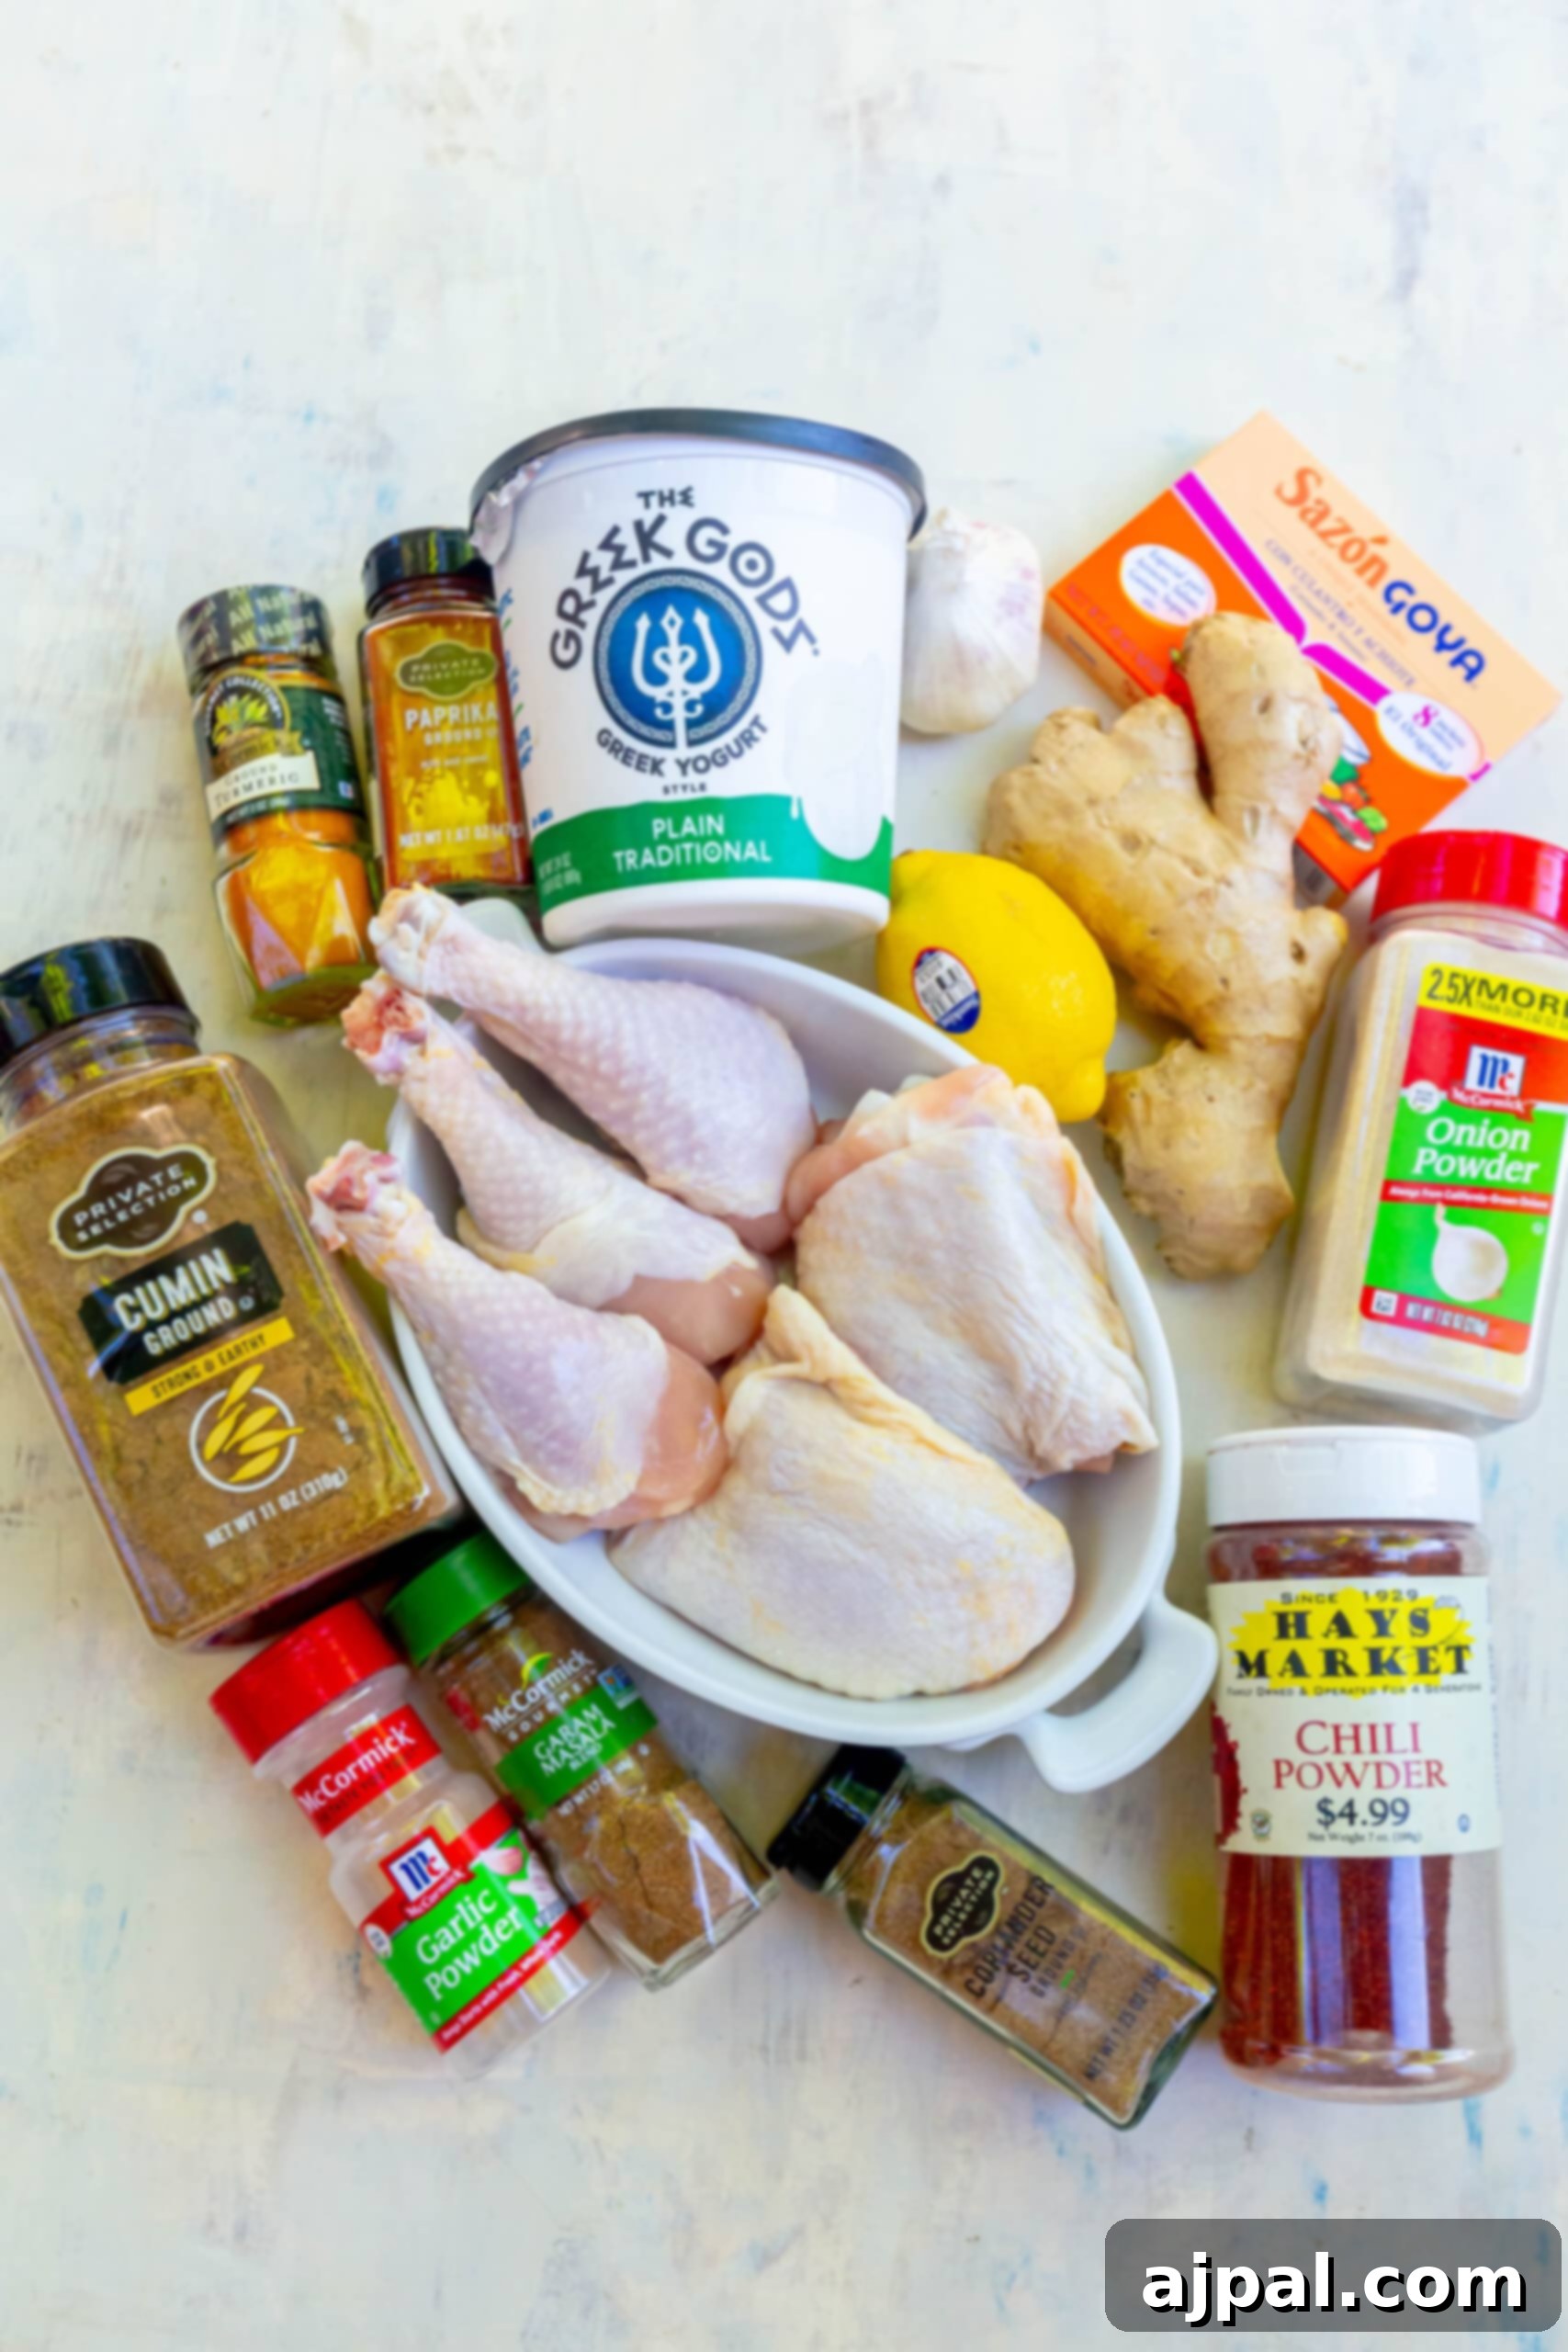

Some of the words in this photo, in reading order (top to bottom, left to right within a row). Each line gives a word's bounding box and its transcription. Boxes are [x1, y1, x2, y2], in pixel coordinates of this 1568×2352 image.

[637, 486, 694, 510] THE
[550, 514, 674, 672] GREEK
[685, 517, 818, 655] GODS
[1274, 466, 1391, 591] Sazón
[1382, 581, 1485, 684] GOYA
[405, 701, 498, 732] PAPRIKA
[595, 727, 665, 777] GREEK
[675, 714, 769, 777] YOGURT
[662, 782, 707, 795] STYLE
[651, 814, 725, 839] PLAIN
[613, 840, 772, 873] TRADITIONAL
[1476, 978, 1568, 1019] MOR
[1427, 1116, 1531, 1152] Onion
[72, 1162, 185, 1228] PRIVATE
[1412, 1148, 1540, 1184] Powder
[75, 1175, 197, 1245] SELECTION
[112, 1248, 238, 1332] CUMIN
[143, 1295, 237, 1358] GROUND
[150, 1365, 202, 1401] STRONG
[220, 1331, 268, 1369] EARTHY
[204, 1522, 233, 1550] NET
[233, 1509, 259, 1533] WT
[1273, 1607, 1432, 1641] HAYS
[1363, 1589, 1419, 1604] 1929
[1235, 1643, 1472, 1679] MARKET
[483, 1649, 595, 1733] McCormick
[534, 1703, 604, 1760] GARAM
[540, 1717, 616, 1778] MASALA
[1295, 1720, 1423, 1756] CHILI
[298, 1722, 416, 1813] McCormick
[1272, 1758, 1449, 1792] POWDER
[1316, 1796, 1411, 1829] $4.99
[416, 1889, 498, 1964] Garlic
[932, 1867, 984, 1937] PRIVATE
[941, 1869, 995, 1946] SELECTION
[423, 1906, 524, 2002] Powder
[1007, 1925, 1056, 1984] SEED
